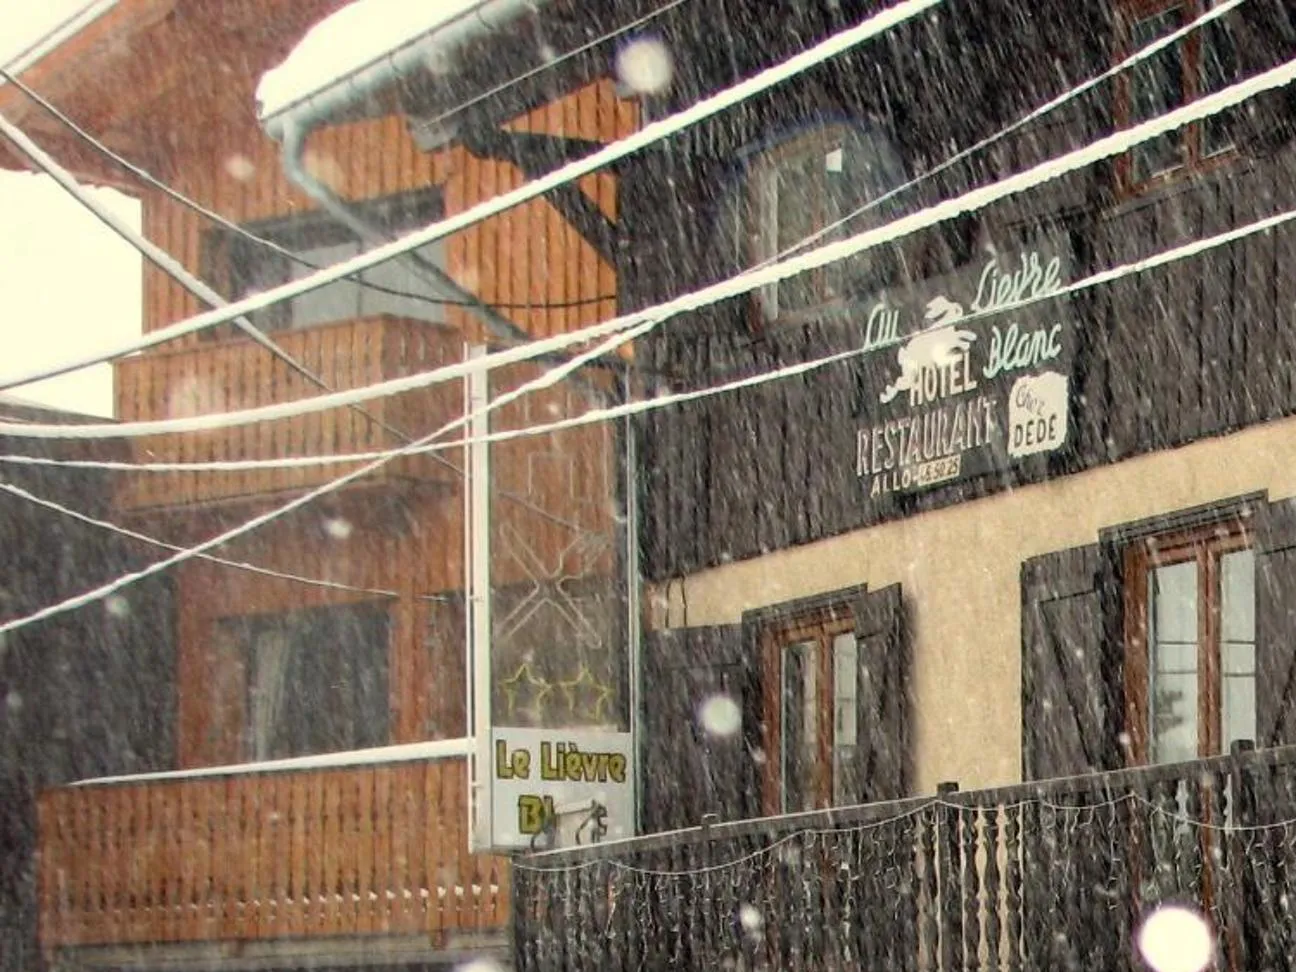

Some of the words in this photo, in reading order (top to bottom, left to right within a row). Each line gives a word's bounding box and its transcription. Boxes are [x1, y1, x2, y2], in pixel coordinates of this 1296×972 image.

[909, 350, 977, 407] HOTEL
[982, 323, 1062, 379] Blanc
[856, 397, 998, 476] RESTAURANT
[495, 739, 531, 780] Le
[540, 740, 628, 783] Lièvre
